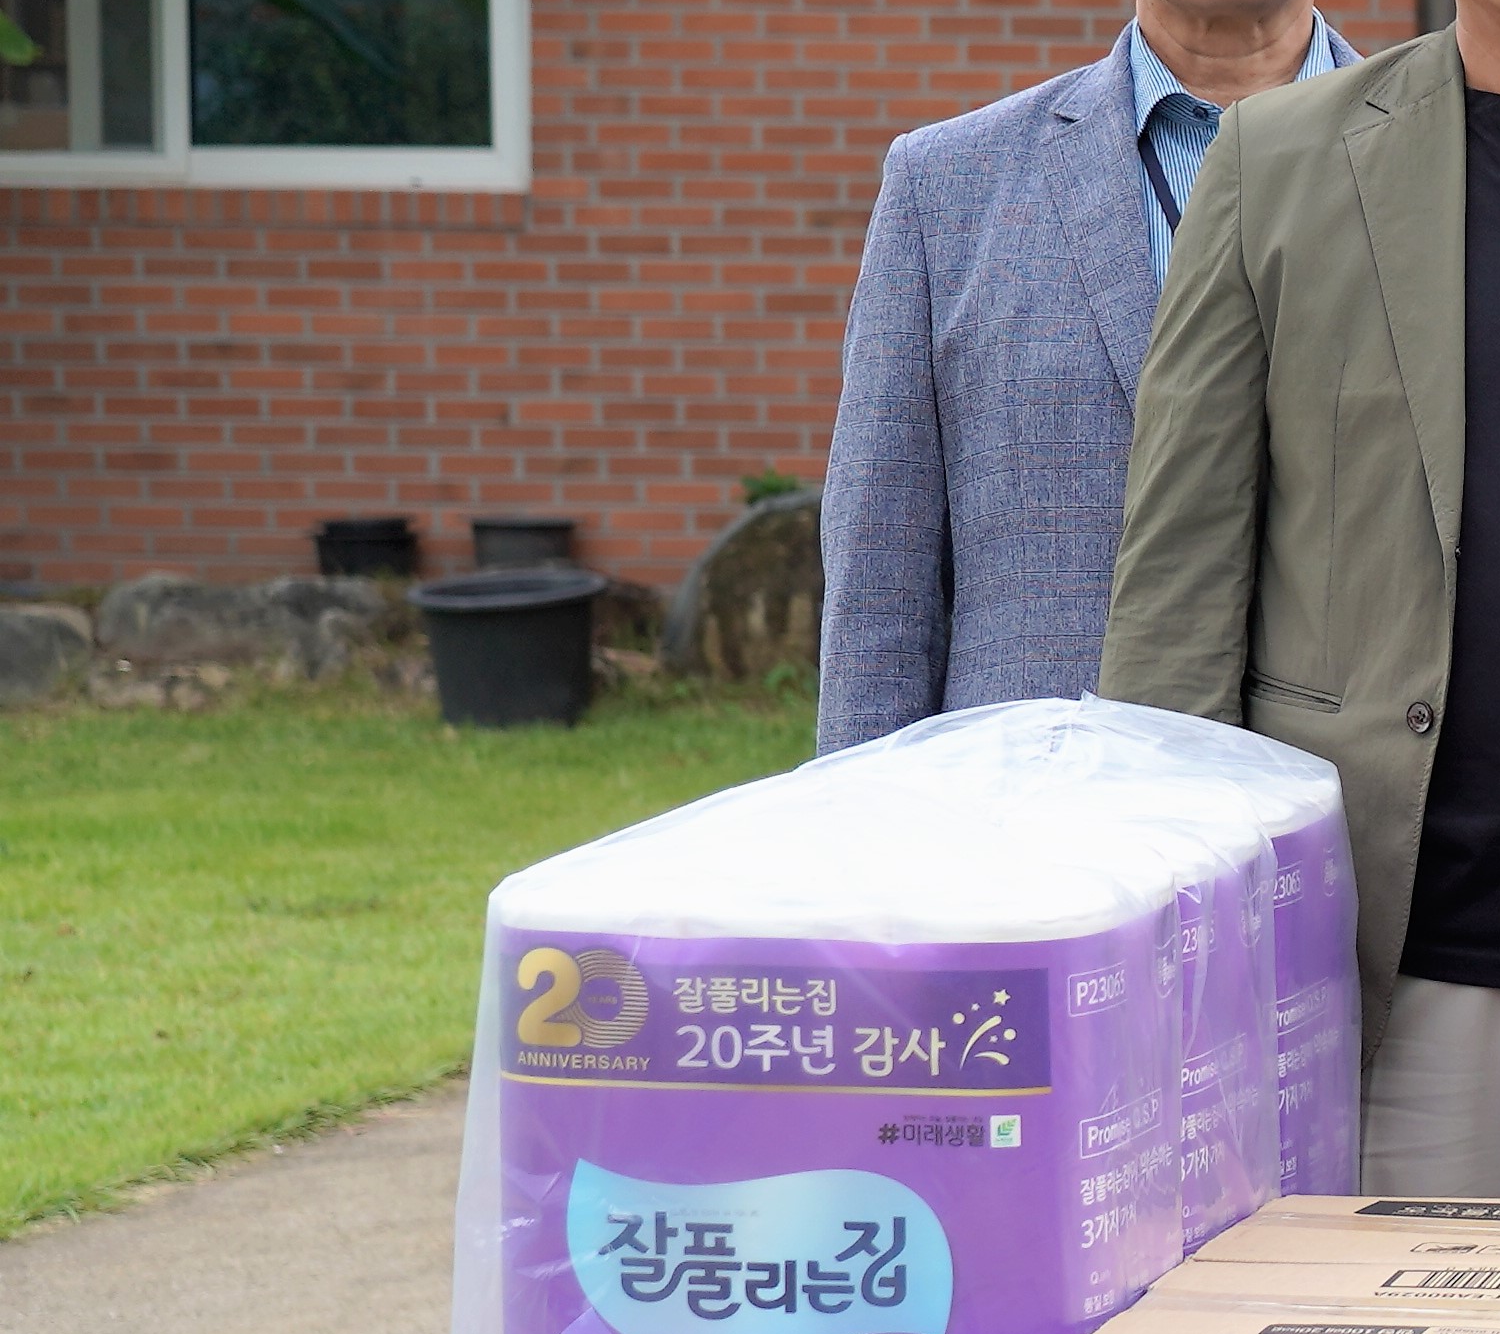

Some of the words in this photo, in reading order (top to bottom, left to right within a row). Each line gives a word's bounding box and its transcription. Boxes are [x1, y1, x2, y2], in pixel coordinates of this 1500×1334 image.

[673, 977, 836, 1016] 잘풀리는집
[517, 1050, 650, 1072] ANNIVERSARY
[676, 1025, 835, 1075] 20주년
[854, 1027, 945, 1077] 감사
[598, 1212, 906, 1319] 잘풀리는집
